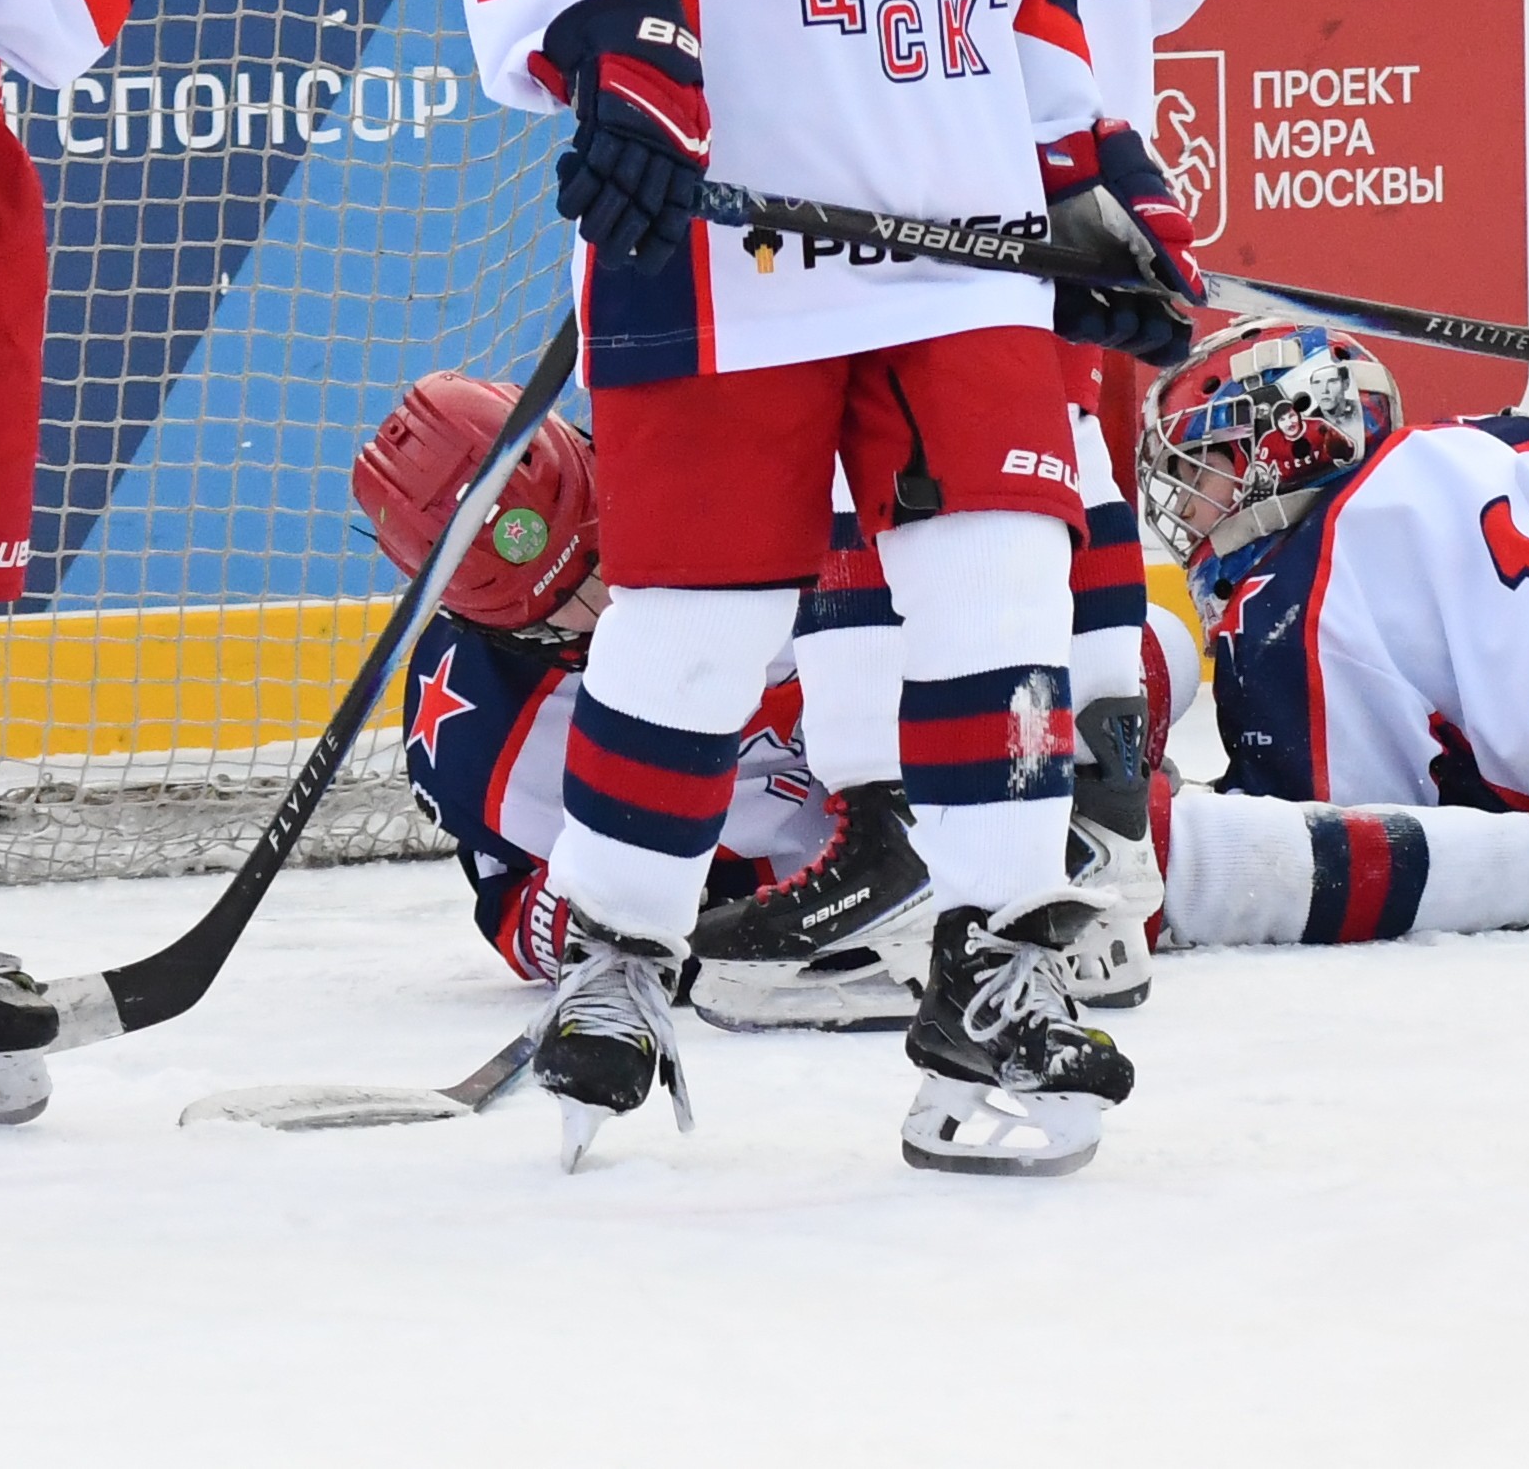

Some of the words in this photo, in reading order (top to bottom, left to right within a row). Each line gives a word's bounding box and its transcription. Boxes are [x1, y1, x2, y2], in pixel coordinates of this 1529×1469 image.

[1253, 65, 1420, 109] ПРОЕКТ
[57, 65, 458, 154] СПОНСОР
[1254, 118, 1375, 159] МЭРА
[1255, 165, 1443, 210] МОСКВЫ
[897, 221, 1024, 265] BAUER
[1002, 449, 1080, 492] BAU
[532, 534, 581, 598] BAUER
[269, 730, 339, 853] FLYLITE
[802, 886, 871, 930] BAUER
